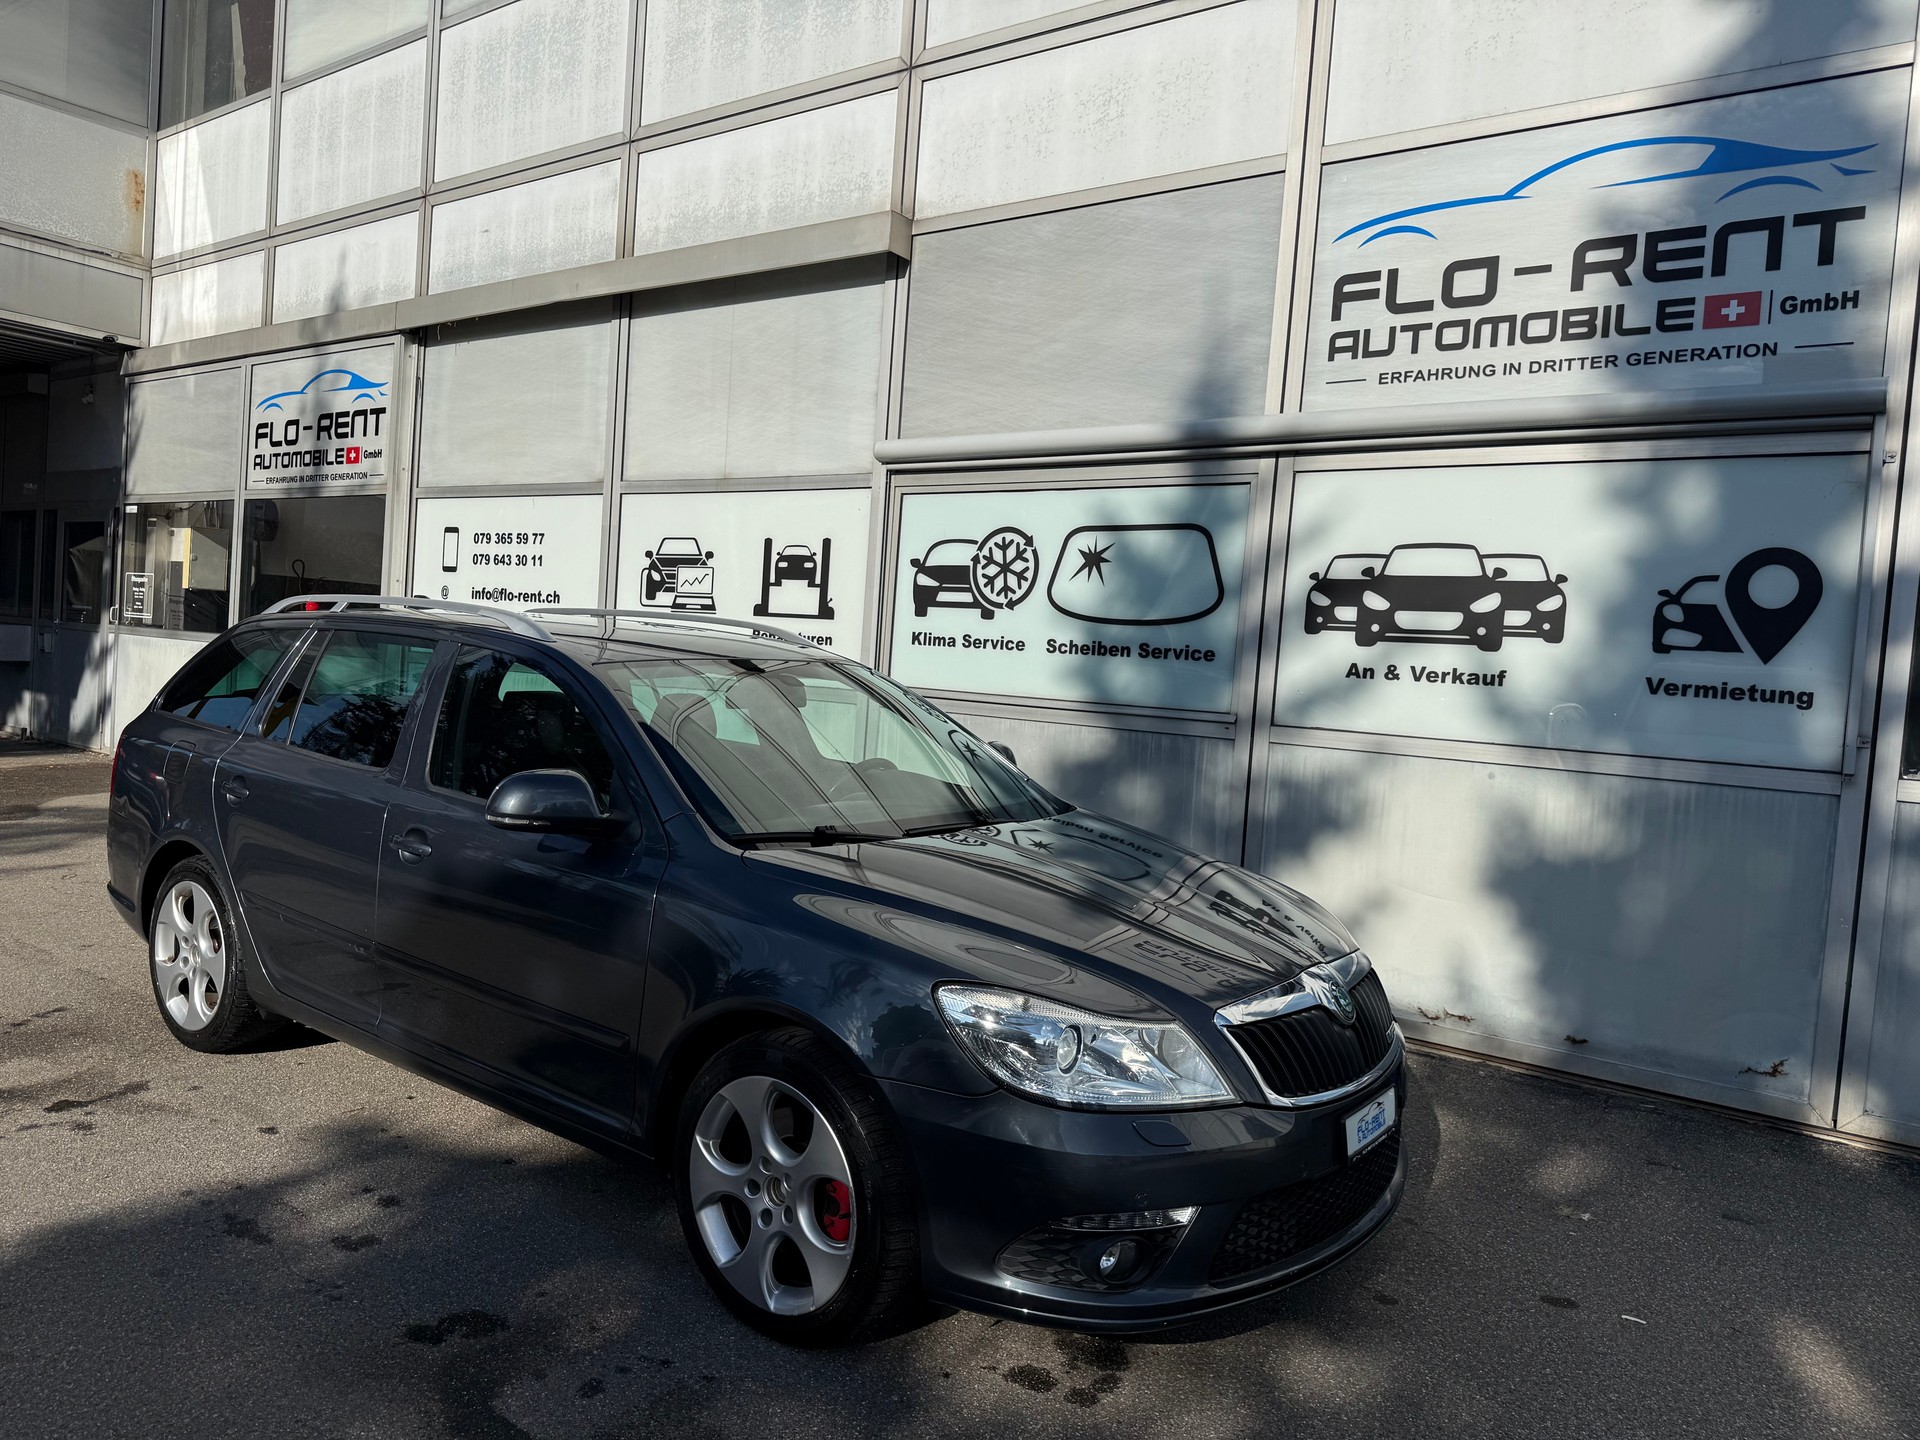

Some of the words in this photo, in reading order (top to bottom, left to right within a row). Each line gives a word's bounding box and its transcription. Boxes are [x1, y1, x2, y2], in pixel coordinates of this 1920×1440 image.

[1328, 297, 1696, 361] AUTOMOBILE
[1780, 290, 1860, 315] GmbH
[1378, 364, 1496, 385] ERFAHRUNG
[1502, 361, 1522, 376] IN
[1528, 353, 1619, 374] DRITTER
[1626, 341, 1778, 366] GENERATION
[253, 448, 345, 471] AUTOMOBILE
[363, 448, 383, 460] GmbH
[265, 475, 298, 485] ERFAHRUNG
[299, 475, 305, 483] IN
[306, 473, 329, 483] DRITTER
[330, 471, 368, 481] GENERATION
[473, 532, 492, 545] 079
[494, 532, 513, 545] 365
[515, 532, 529, 545] 59
[531, 532, 545, 545] 77
[472, 553, 491, 566] 079
[493, 553, 512, 567] 643
[514, 554, 528, 567] 30
[530, 554, 543, 567] 11
[471, 586, 561, 604] info@flo-rent.ch
[911, 631, 957, 648] Klima
[961, 633, 1026, 652] Service
[1045, 638, 1131, 658] Scheiben
[1137, 642, 1216, 663] Service
[1344, 662, 1375, 680] An
[1383, 664, 1401, 681] &
[1409, 665, 1508, 688] Verkauf
[1645, 676, 1815, 711] Vermietung
